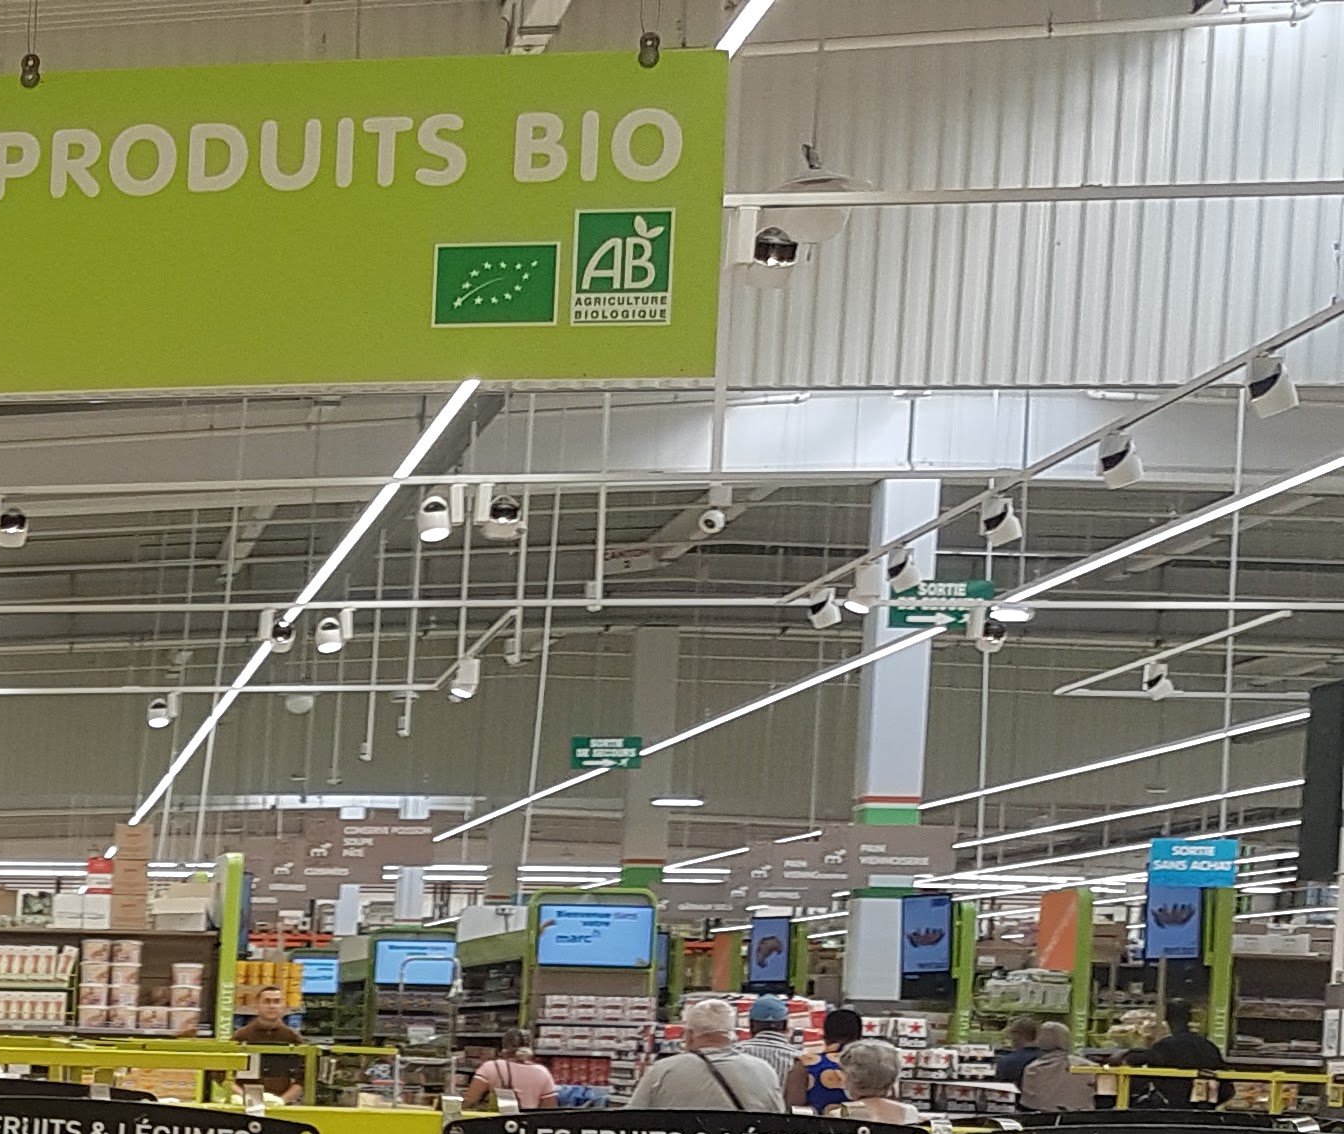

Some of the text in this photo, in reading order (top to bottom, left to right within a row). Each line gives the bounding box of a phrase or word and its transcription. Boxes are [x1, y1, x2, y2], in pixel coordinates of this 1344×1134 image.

[513, 107, 684, 184] BIO
[580, 234, 657, 292] AB
[574, 294, 669, 308] AGRICULTURE
[574, 308, 668, 321] BIOLOGIQUE
[916, 582, 968, 597] SORTIE
[1171, 845, 1216, 857] SORTIE
[1153, 859, 1233, 872] SANS ACHAT
